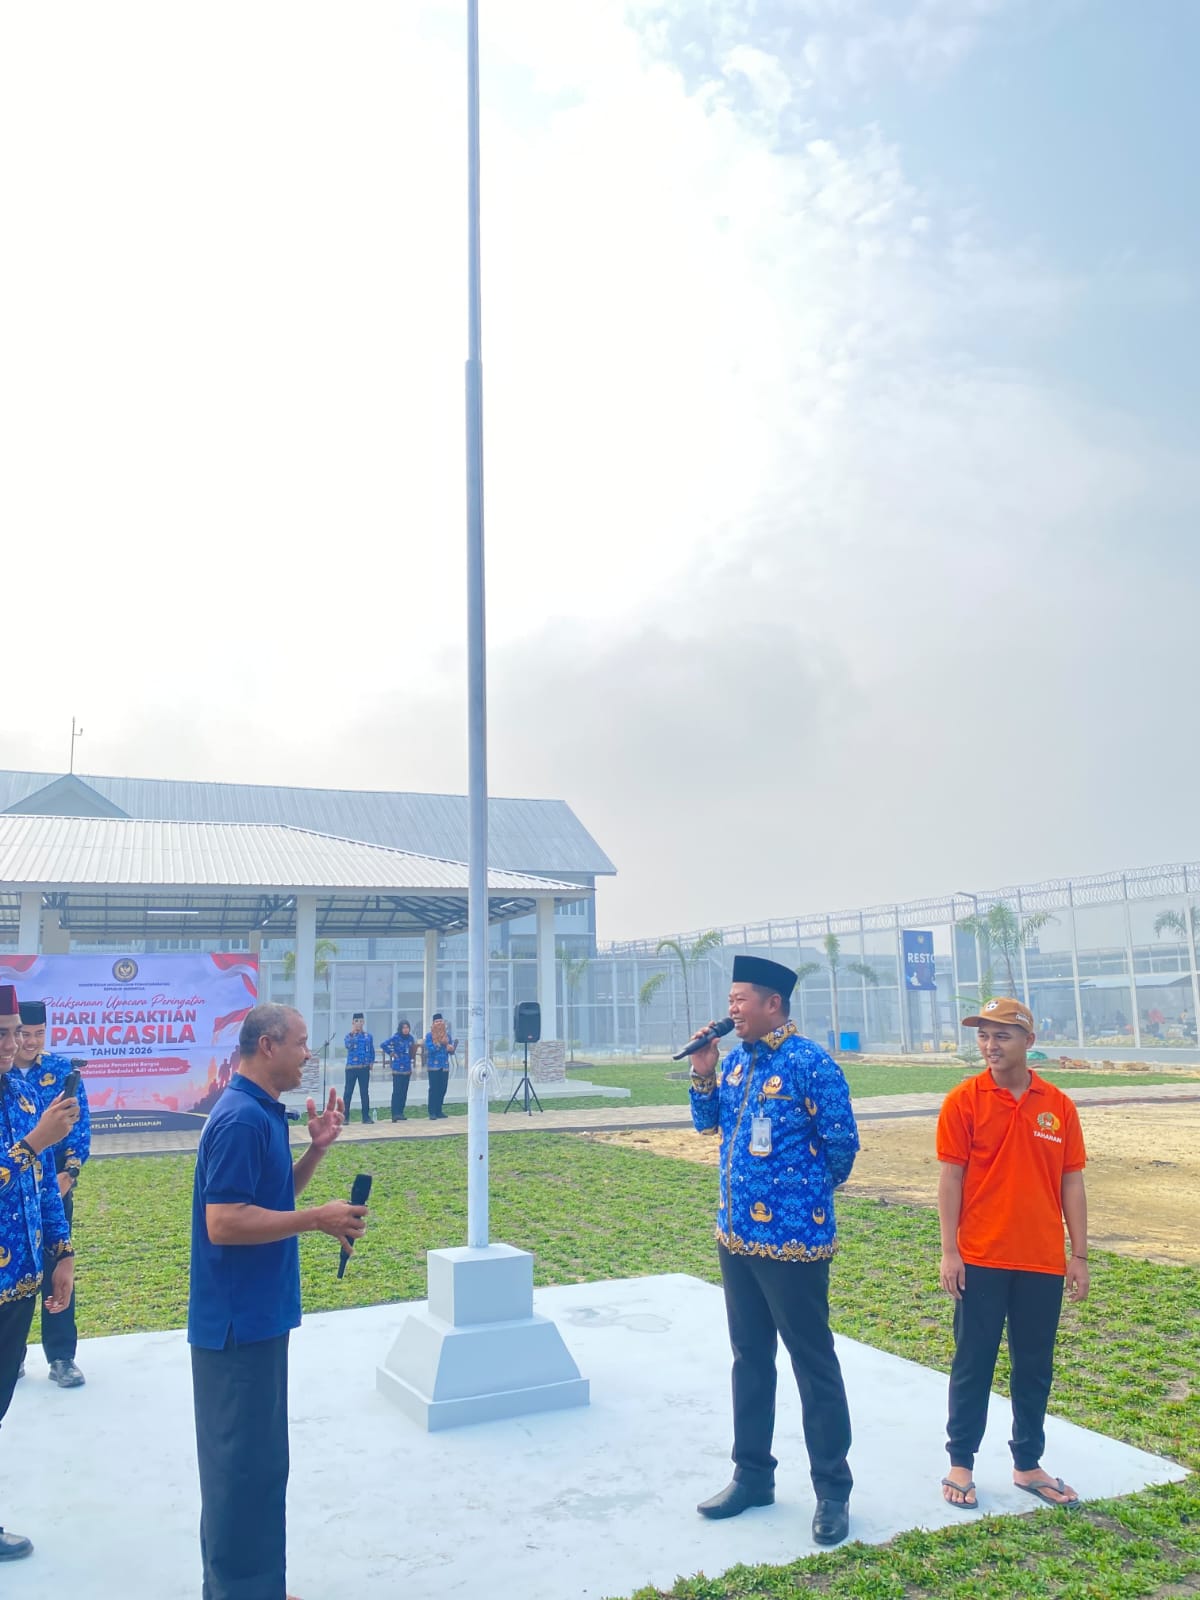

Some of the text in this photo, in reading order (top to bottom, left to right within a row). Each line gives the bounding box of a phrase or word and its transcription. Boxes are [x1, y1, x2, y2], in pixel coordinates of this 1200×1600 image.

[41, 993, 206, 1009] Pelaksanaan Upacara Peringatan
[51, 1009, 197, 1025] HARI KESAKTIAN
[50, 1024, 196, 1047] PANCASILA
[91, 1047, 153, 1056] TAHUN 2026
[1033, 1130, 1063, 1144] TAHANAN
